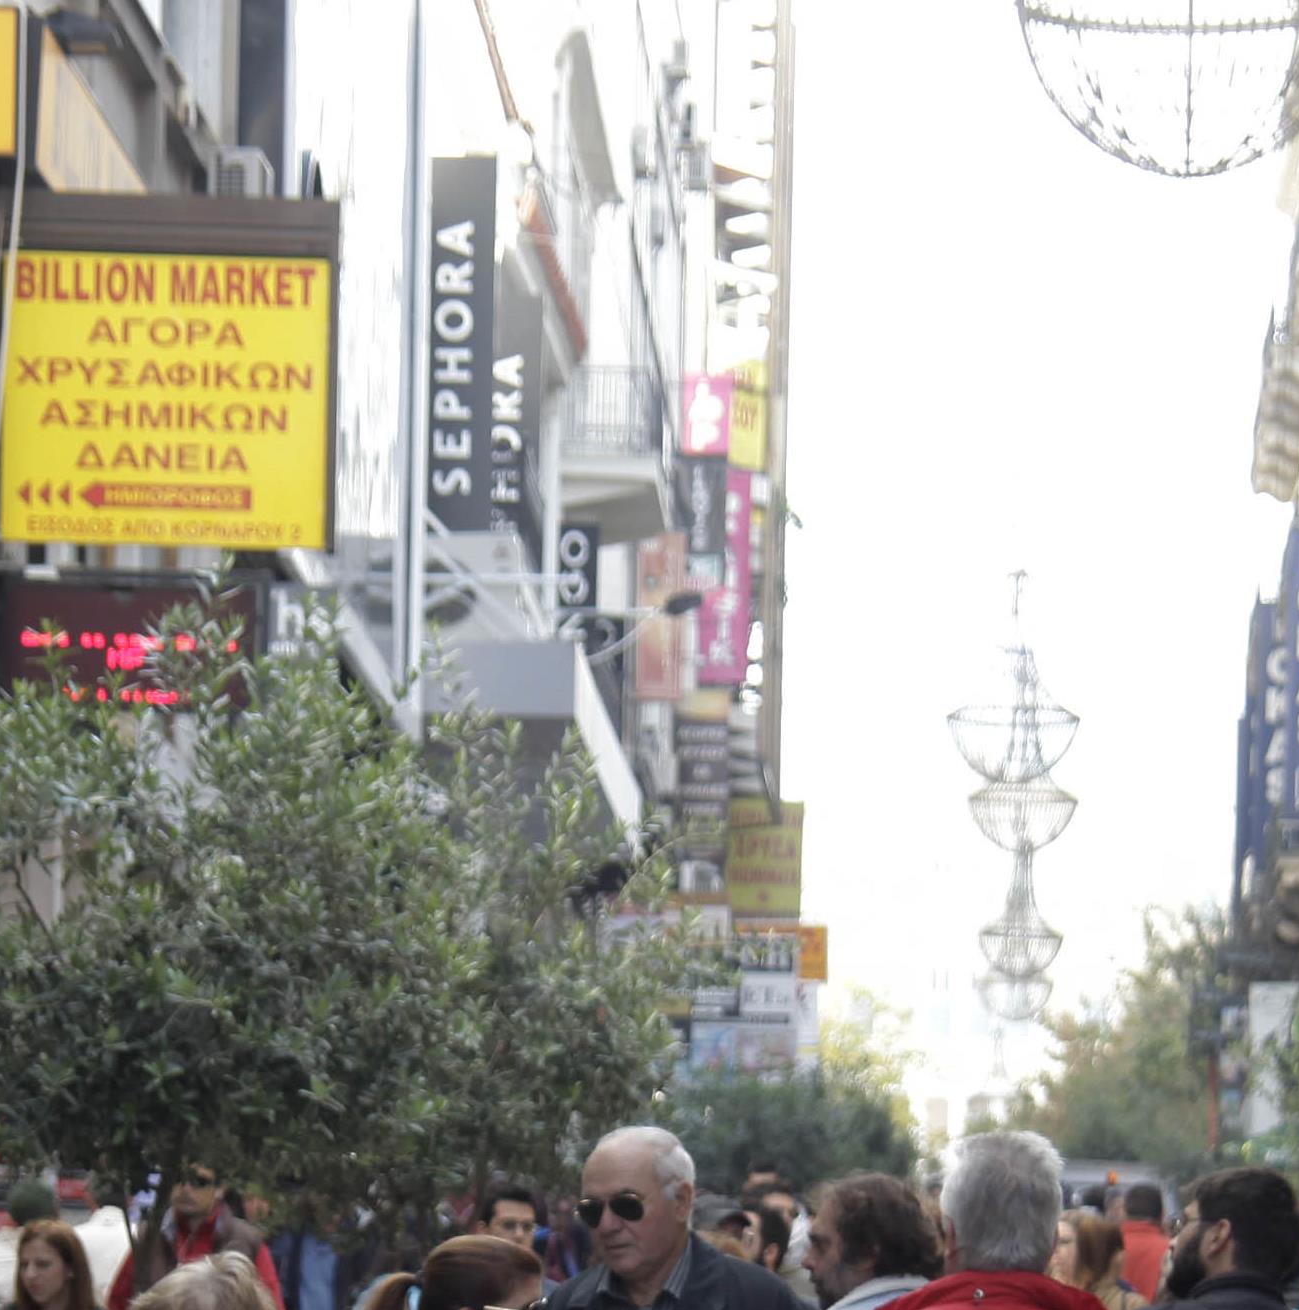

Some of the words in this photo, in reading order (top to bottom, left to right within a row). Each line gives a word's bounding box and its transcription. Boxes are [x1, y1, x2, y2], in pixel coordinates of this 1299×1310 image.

[15, 260, 155, 303] BILLION
[170, 264, 317, 308] MARKET
[87, 316, 246, 349] ΑΓΟΡΑ
[15, 355, 313, 391] ΧΡΥΣΑΦΙΚΩΝ
[431, 220, 476, 497] SEPHORA
[39, 399, 288, 434] ΑΣΗΜΙΚΩΝ
[76, 441, 249, 473] ΔΑΝΕΙΑ
[26, 515, 115, 535] ΕΙΣΟΔΟΣ
[121, 518, 166, 537] ΑΠΟ
